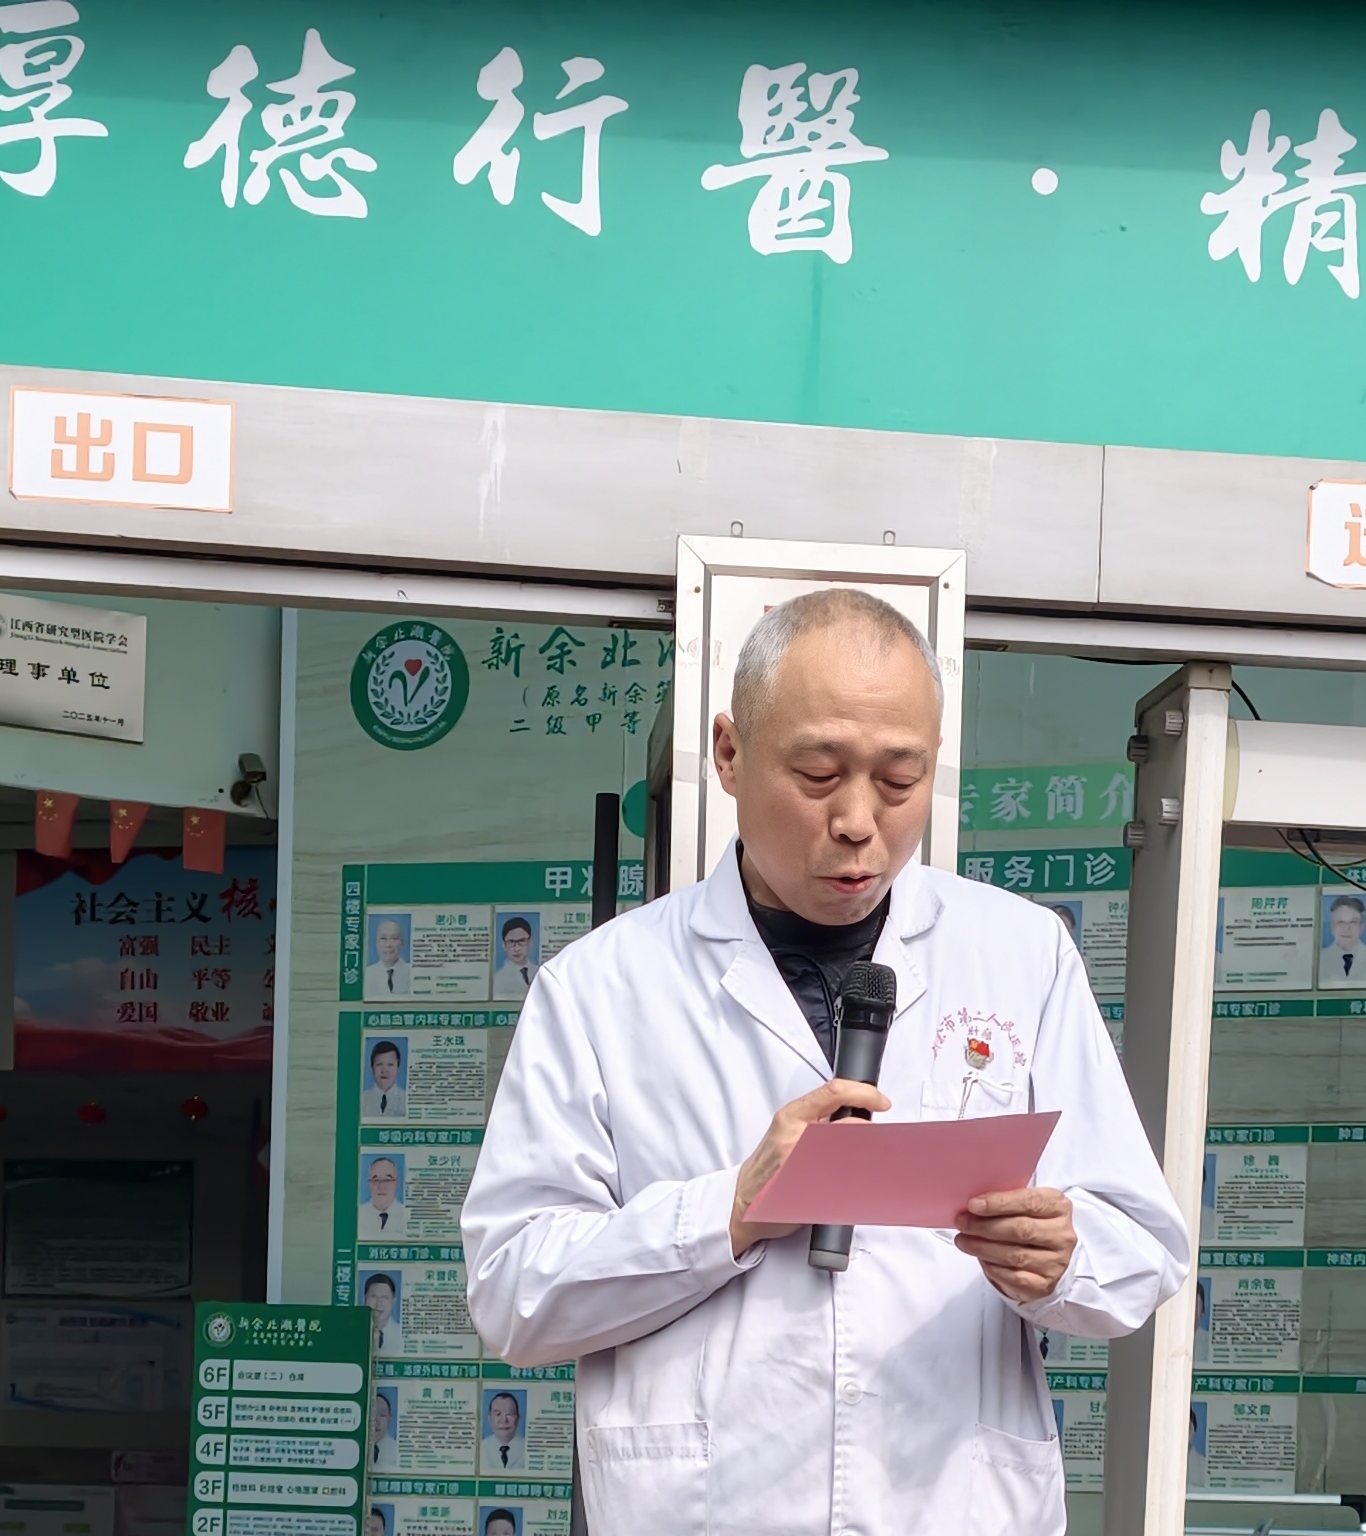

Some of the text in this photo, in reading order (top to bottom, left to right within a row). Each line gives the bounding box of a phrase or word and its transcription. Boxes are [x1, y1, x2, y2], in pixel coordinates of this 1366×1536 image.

[48, 410, 196, 486] 出口
[10, 617, 128, 647] 江西省研究型医院学会
[482, 626, 673, 678] 新余北
[70, 878, 275, 926] 社会主义核
[118, 934, 231, 957] 富强 民主
[118, 968, 231, 991] 自由 平等
[117, 1002, 230, 1023] 爱国 敬业
[203, 1366, 228, 1383] 6F
[202, 1404, 226, 1420] 5F
[200, 1441, 224, 1457] 4F
[198, 1479, 222, 1496] 3F
[197, 1517, 221, 1533] 2F
